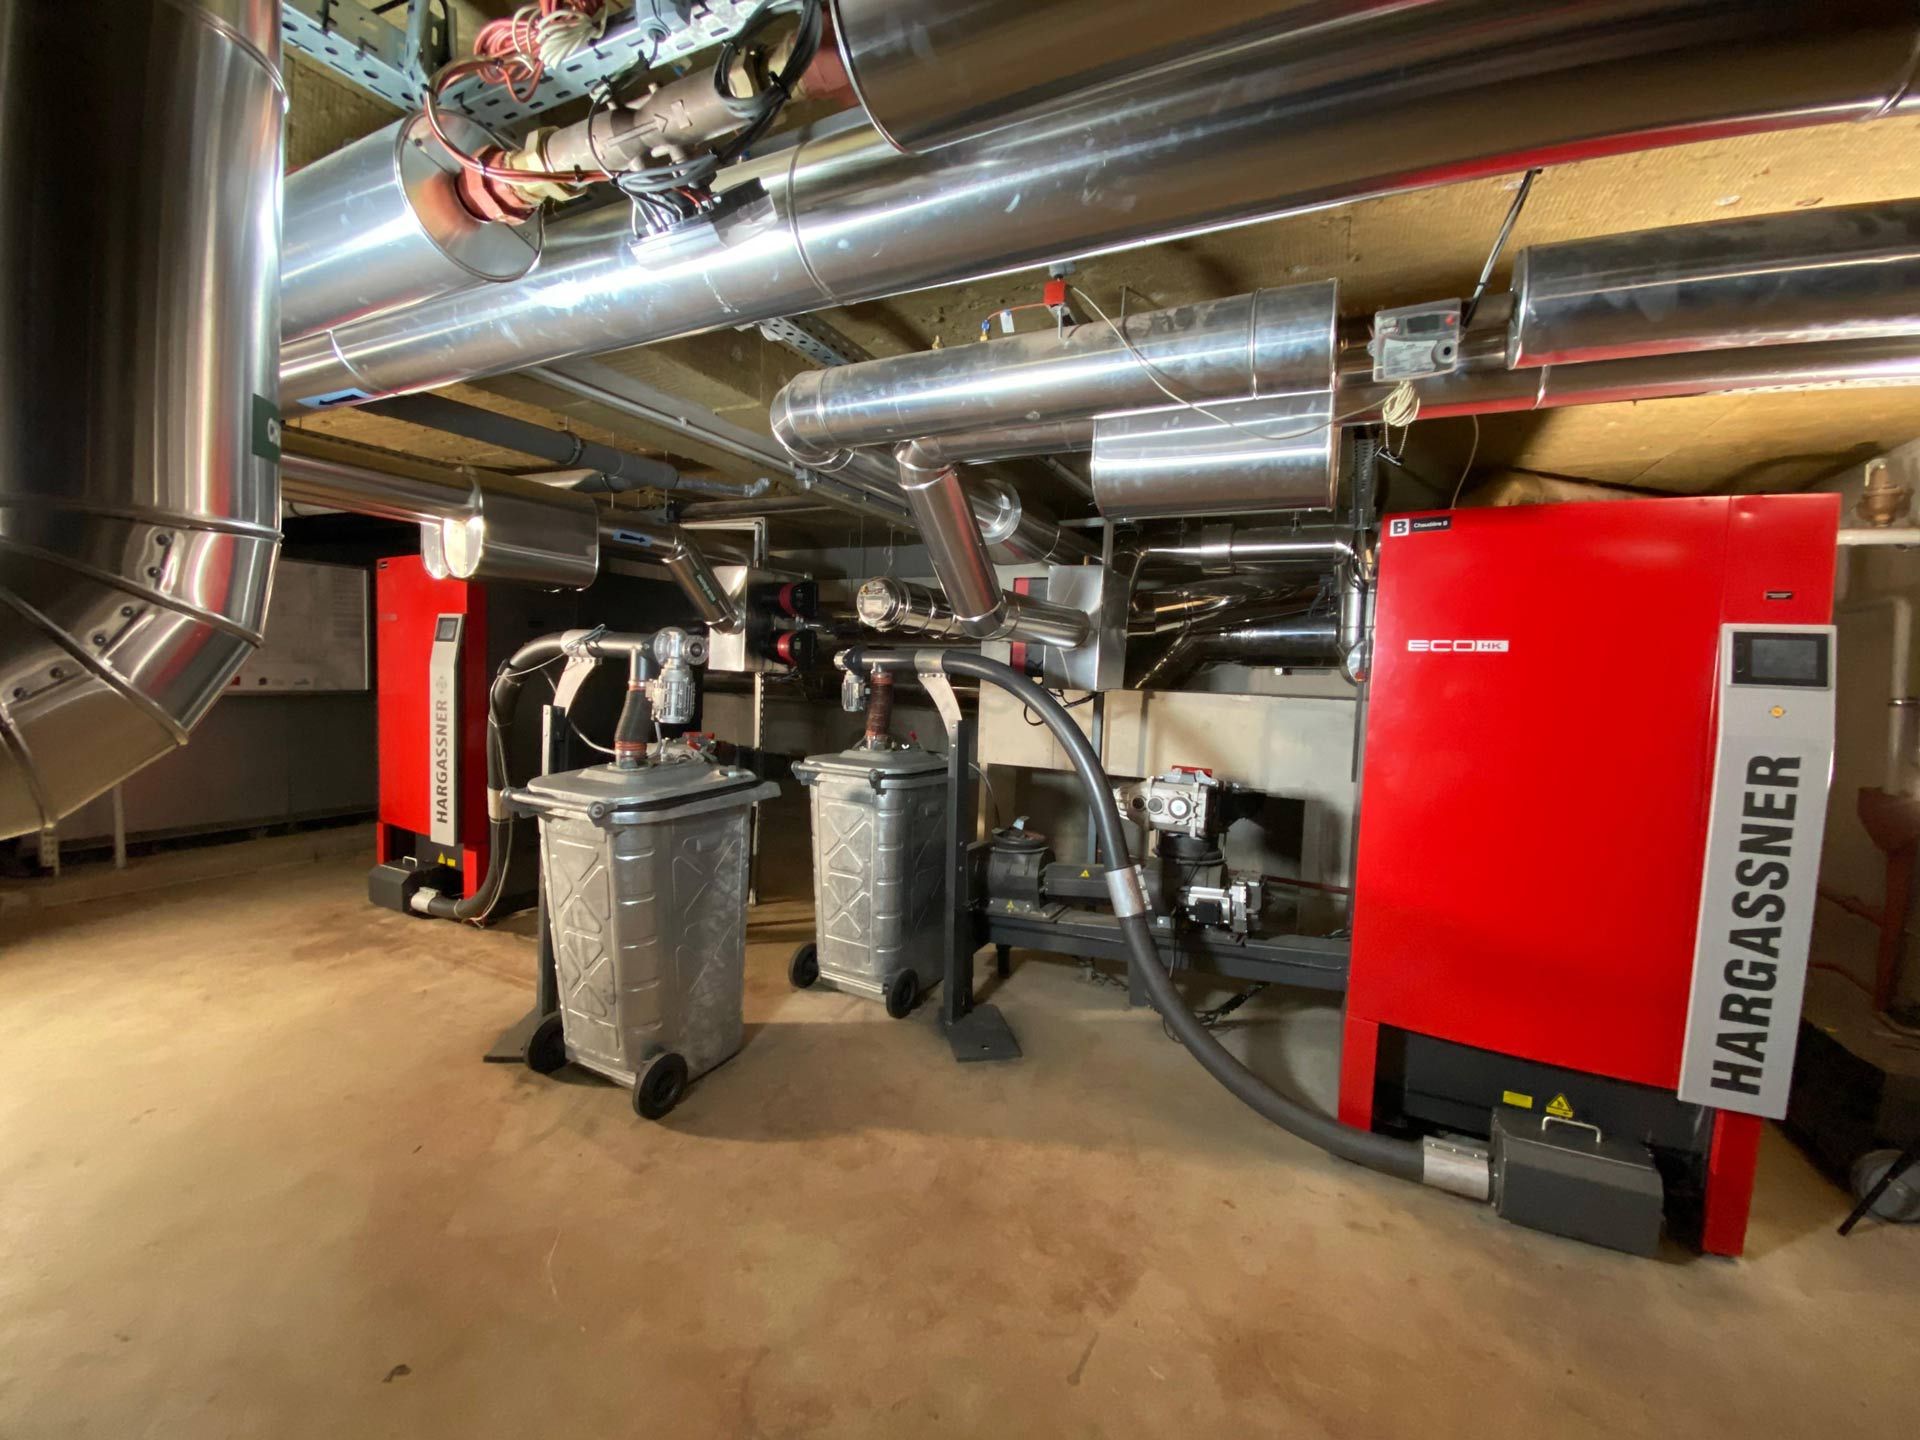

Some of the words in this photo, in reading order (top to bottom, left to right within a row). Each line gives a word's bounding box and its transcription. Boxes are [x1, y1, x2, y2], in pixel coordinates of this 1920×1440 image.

[1393, 521, 1407, 535] B
[436, 699, 449, 824] HARGASSNER
[1710, 755, 1802, 1096] HARGASSNER
